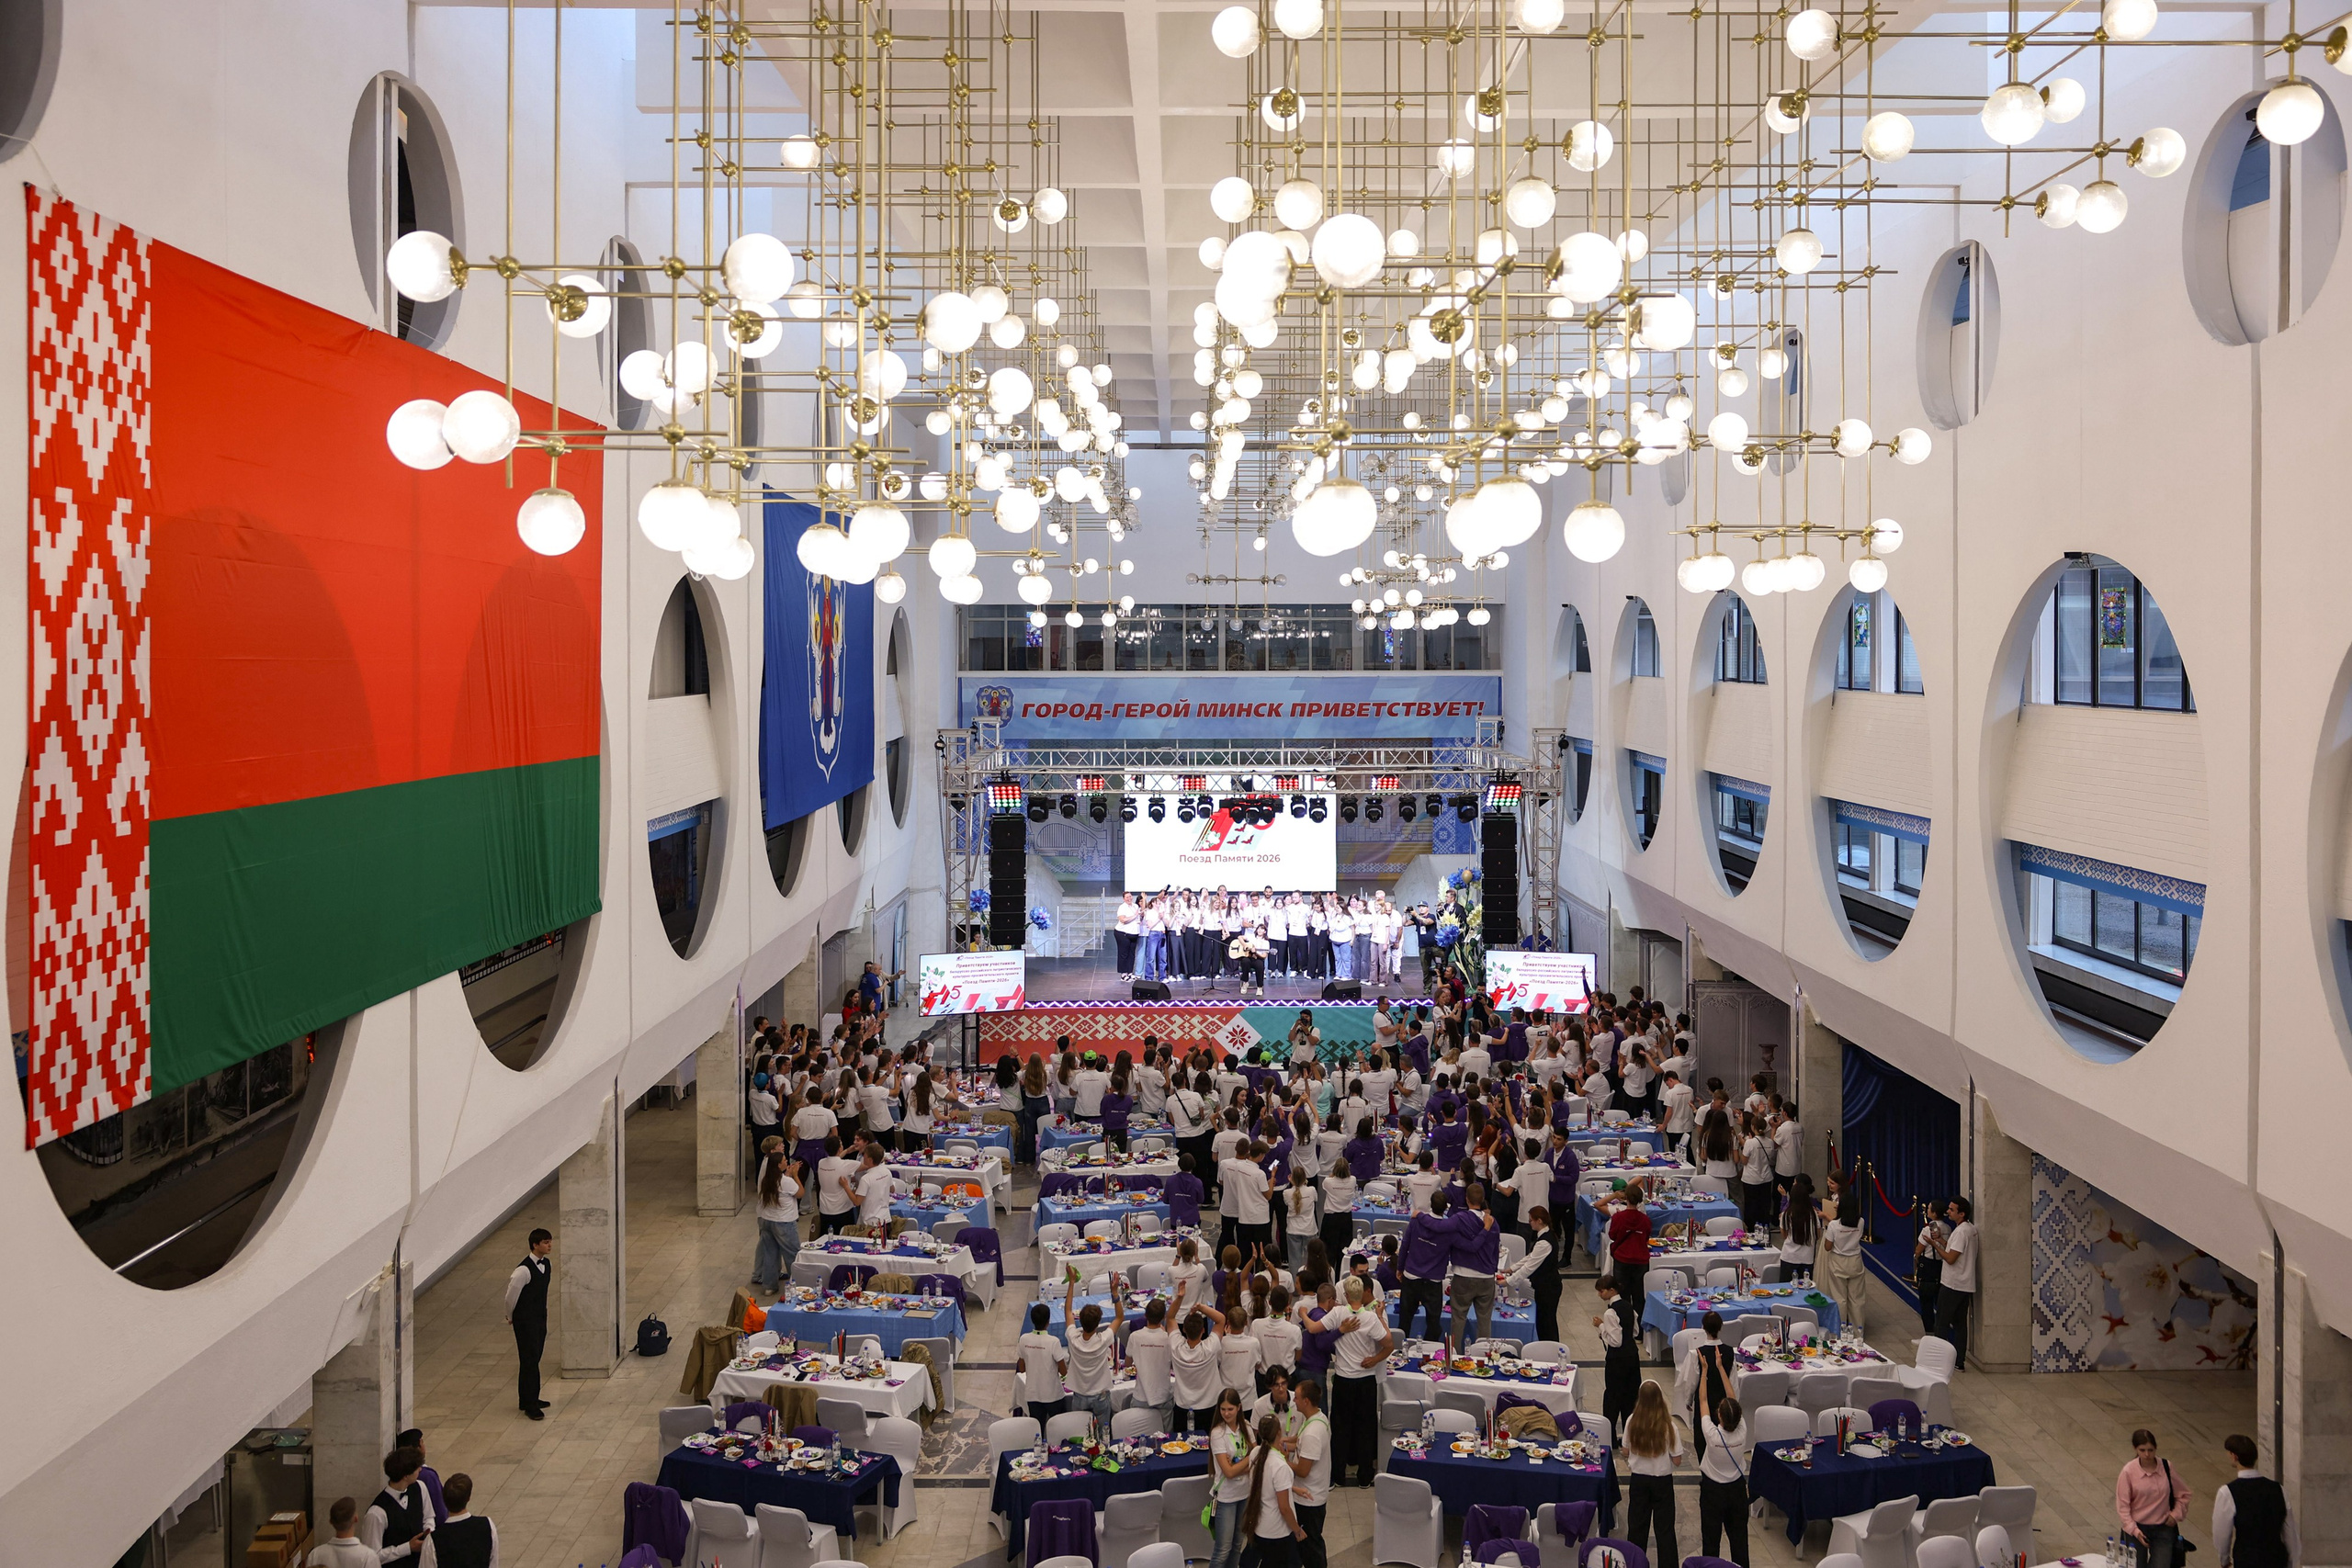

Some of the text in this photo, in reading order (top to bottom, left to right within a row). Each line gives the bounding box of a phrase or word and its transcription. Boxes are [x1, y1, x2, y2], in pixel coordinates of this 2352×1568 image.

[1021, 699, 1485, 720] ГОРОД-ГЕРОЙ МИНСК ПРИВЕТСТВУЕТ!
[1180, 854, 1281, 863] Поезд Памяти 2026
